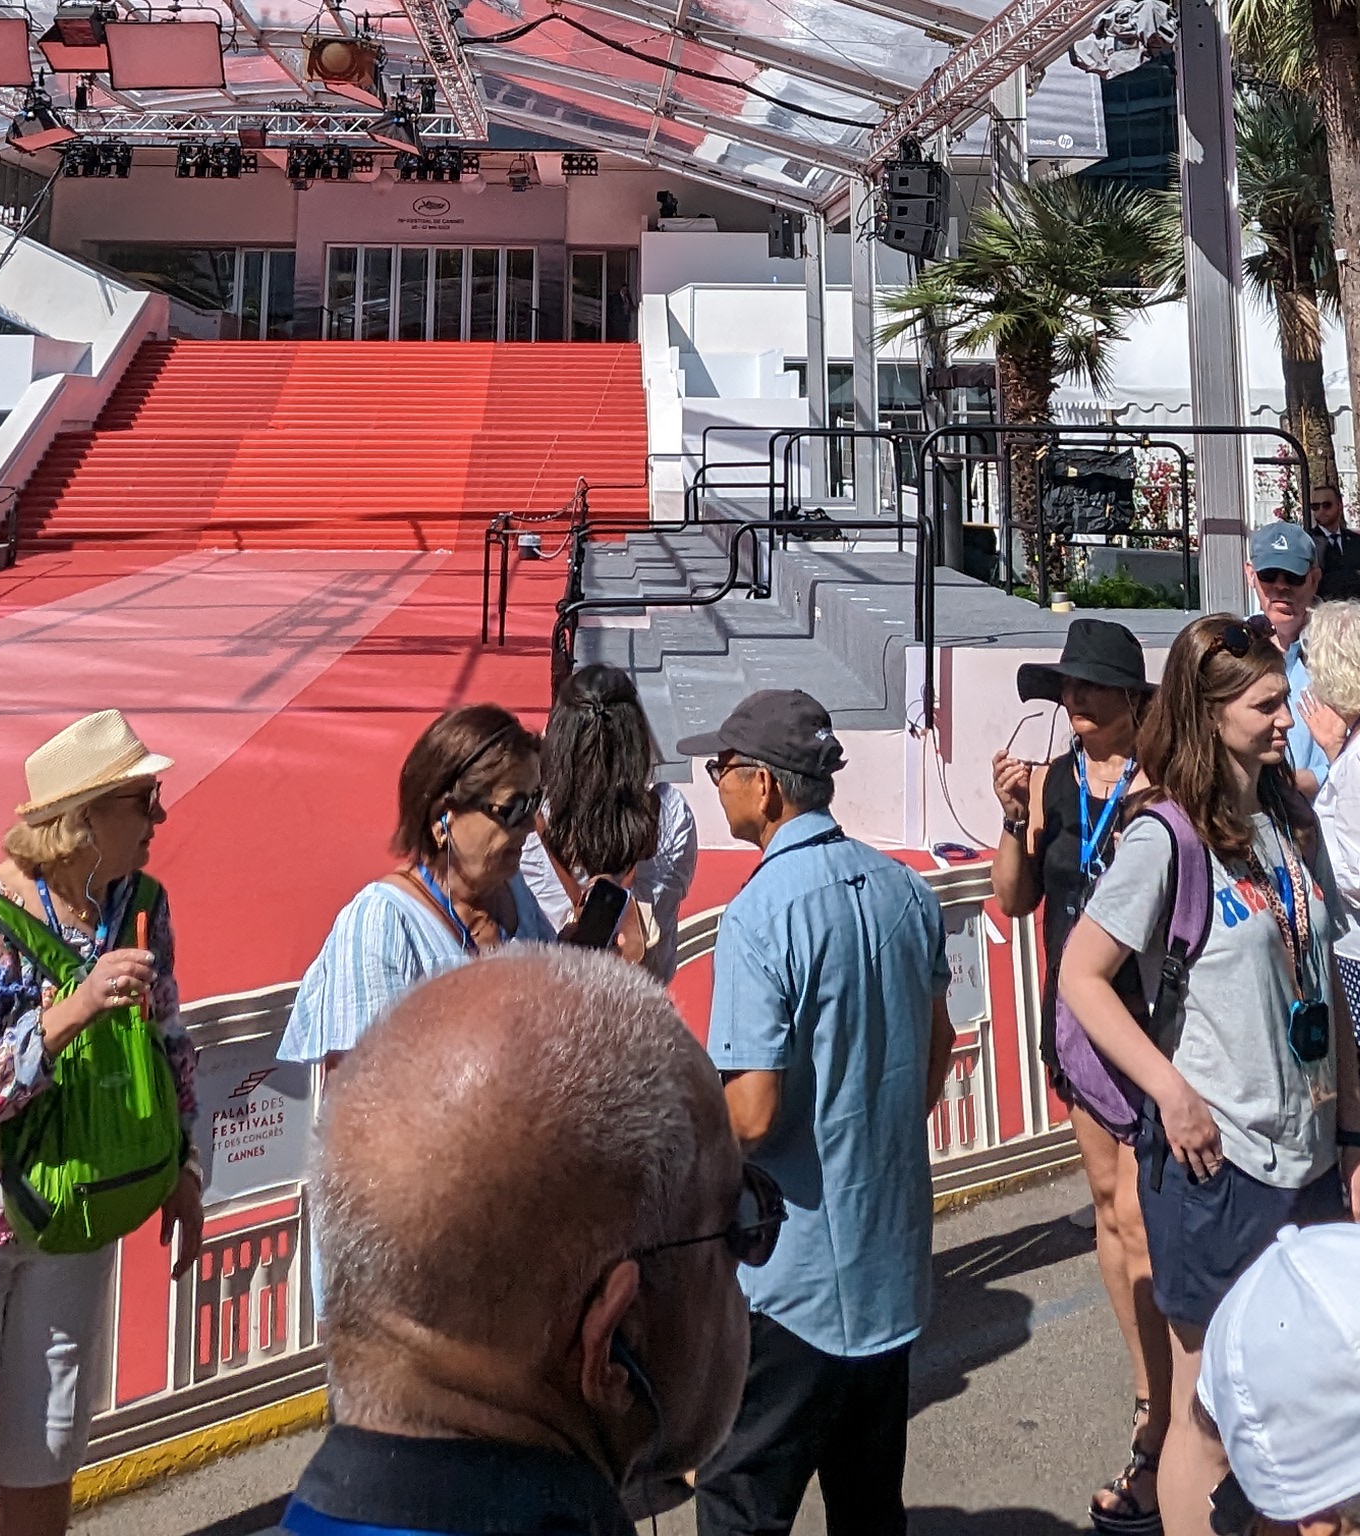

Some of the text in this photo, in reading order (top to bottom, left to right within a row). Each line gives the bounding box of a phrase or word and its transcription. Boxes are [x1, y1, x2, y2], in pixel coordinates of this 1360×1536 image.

[212, 1095, 284, 1123] PALAIS DES
[212, 1112, 284, 1139] FESTIVALS
[227, 1145, 265, 1163] CANNES
